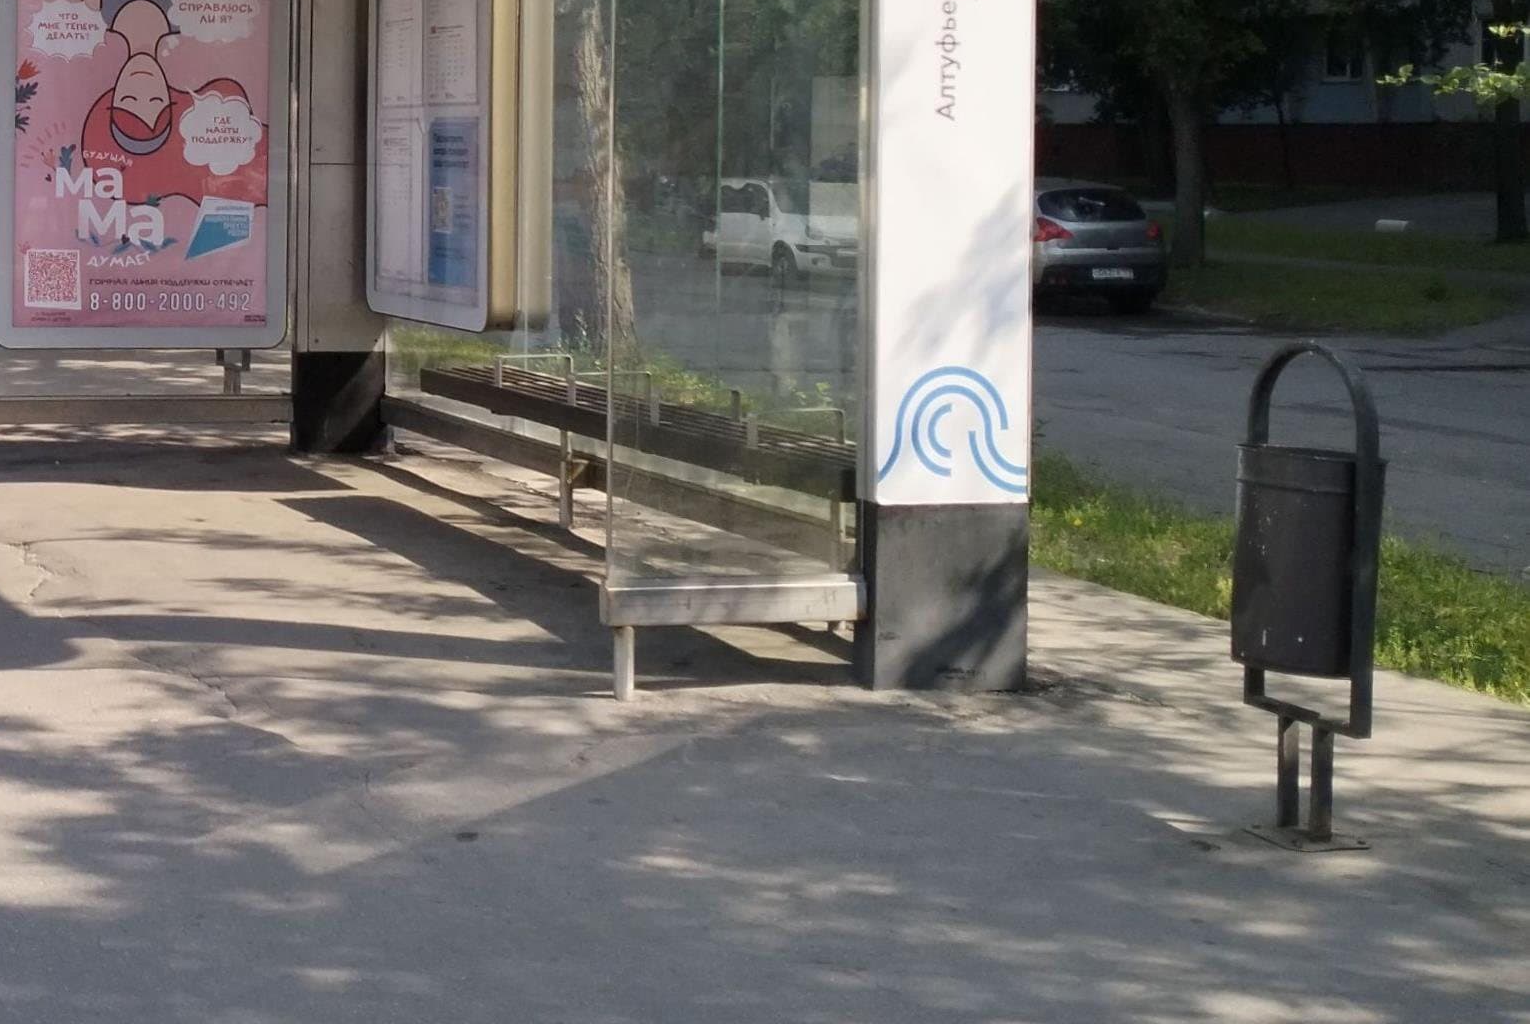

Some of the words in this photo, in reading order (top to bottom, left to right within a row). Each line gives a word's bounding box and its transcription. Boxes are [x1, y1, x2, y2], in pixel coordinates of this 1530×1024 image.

[178, 2, 253, 13] СПРАВЛЮСЬ
[58, 12, 79, 21] ЧТО
[199, 15, 216, 24] ЛИ
[37, 22, 61, 30] МНЕ
[65, 22, 100, 31] ТЕПЕРЬ
[213, 116, 232, 125] ГДЕ
[86, 251, 151, 268] ДУМАЕТ
[90, 292, 250, 311] 8-800-2000-492
